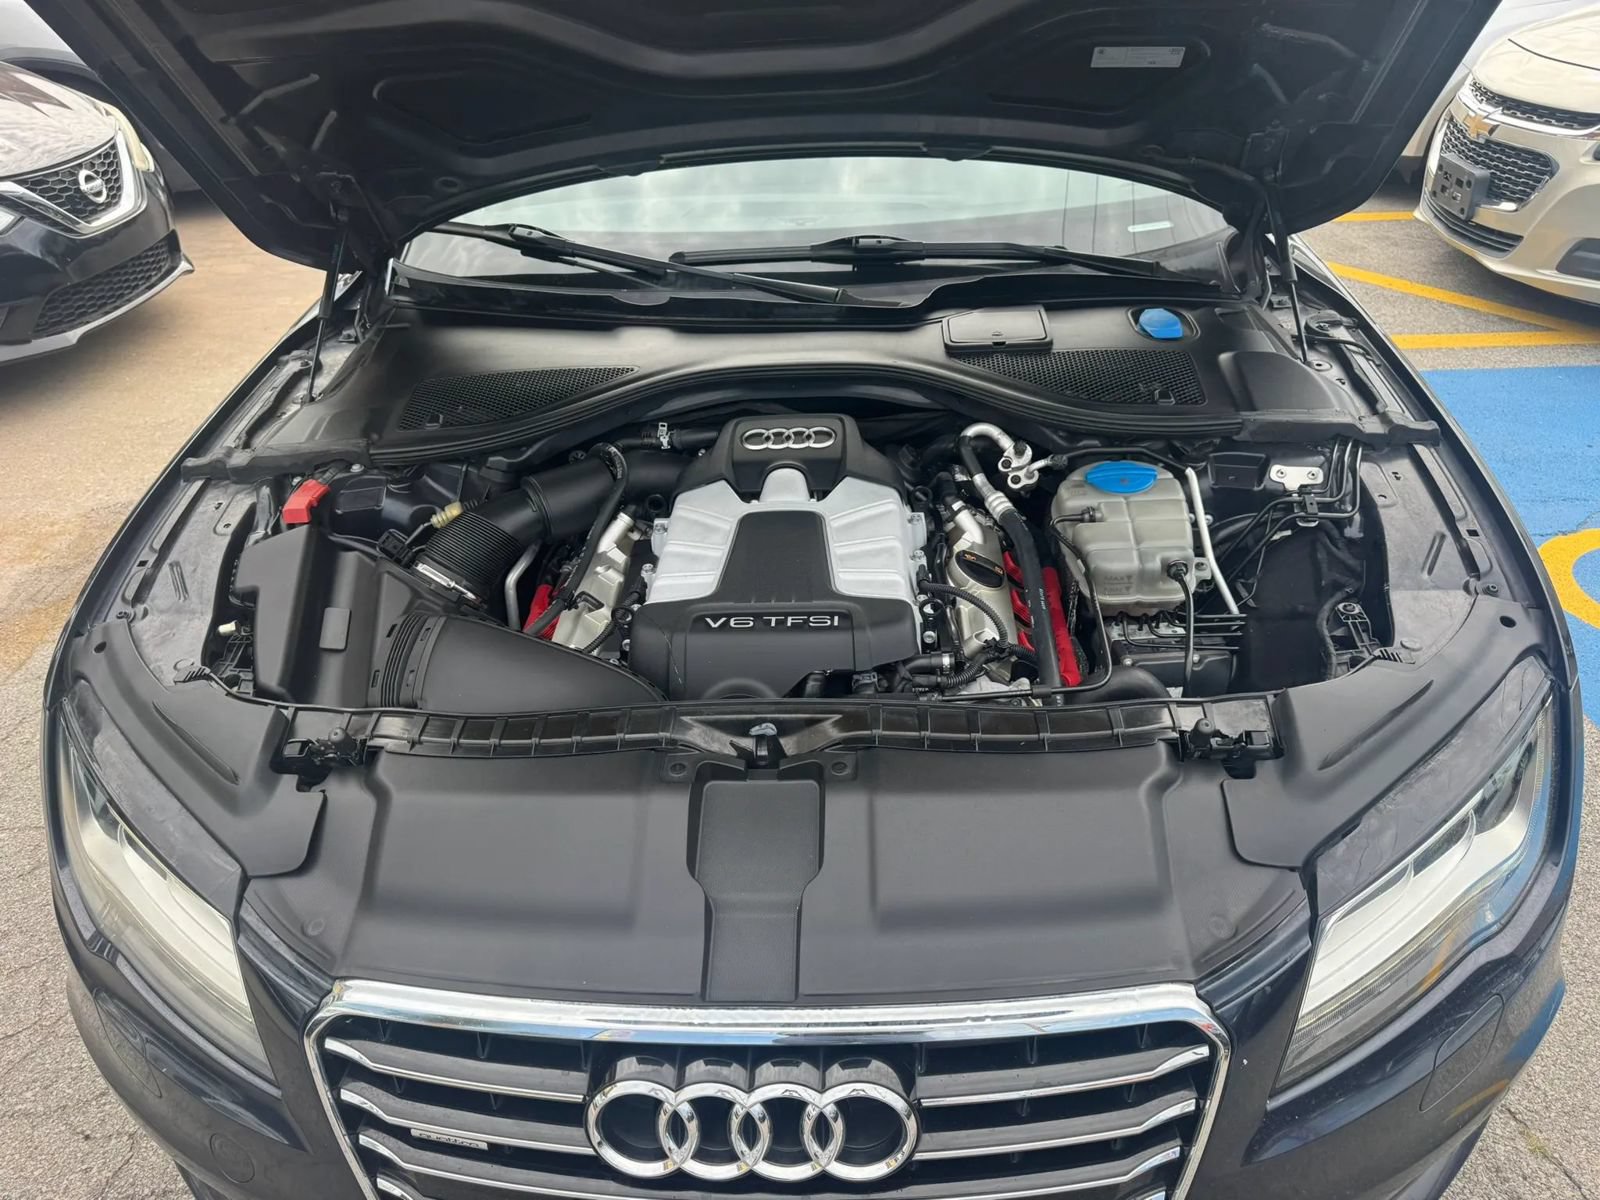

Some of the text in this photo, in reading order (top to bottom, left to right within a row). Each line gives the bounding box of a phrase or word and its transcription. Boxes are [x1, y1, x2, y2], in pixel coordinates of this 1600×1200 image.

[704, 615, 839, 629] V6 TFSI
[417, 1132, 481, 1149] quattro
